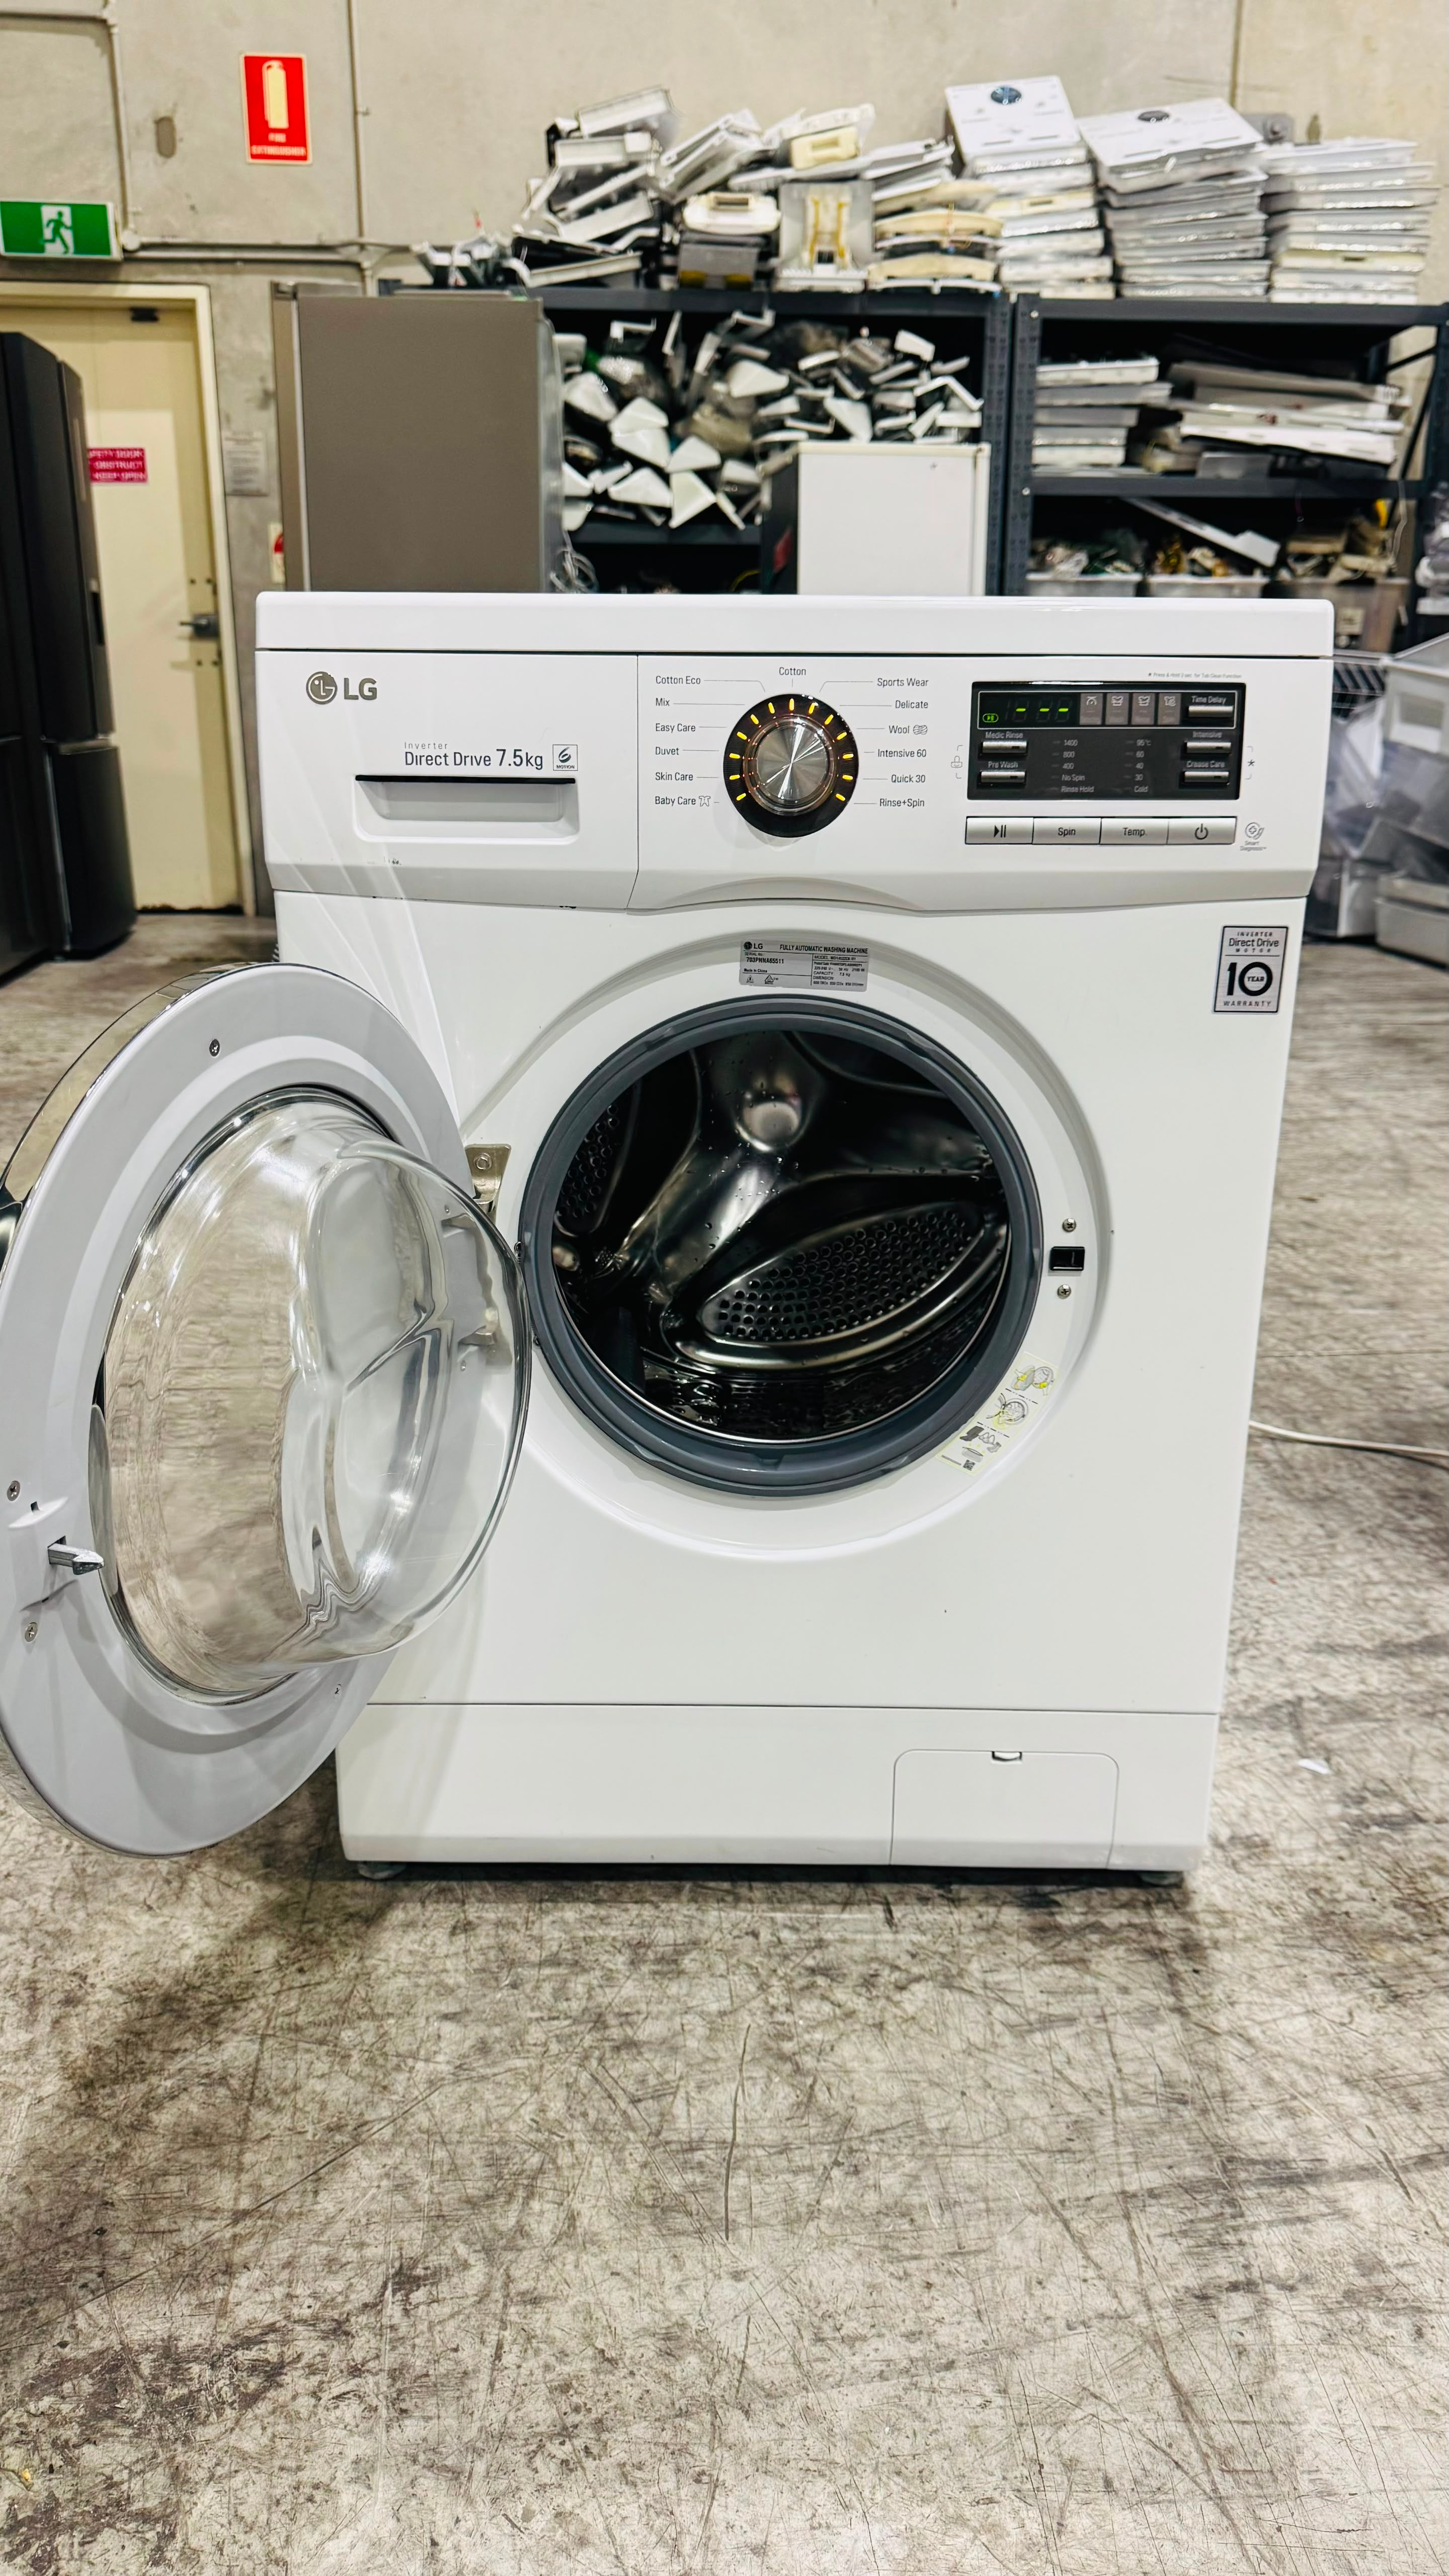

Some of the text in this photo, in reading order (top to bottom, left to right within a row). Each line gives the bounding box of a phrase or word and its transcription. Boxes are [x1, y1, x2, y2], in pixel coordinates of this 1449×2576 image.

[779, 667, 806, 676] Cotton
[656, 676, 701, 685] Cotton Eco
[877, 678, 928, 688] Sports Wear
[344, 678, 377, 700] LG
[656, 698, 670, 707] Mix
[895, 700, 928, 709] Delicate
[1208, 696, 1227, 704] Delay
[656, 723, 696, 734] Easy Care
[889, 725, 910, 734] Wool
[656, 747, 679, 755] Duvet
[878, 749, 927, 758] Intensive 60
[405, 752, 449, 766] Direct
[454, 752, 491, 766] Drive
[656, 772, 693, 781] Skin Care
[891, 775, 926, 783] Quick 30
[655, 796, 696, 807] Baby Care
[879, 798, 925, 808] Rinse+Spin
[1058, 828, 1076, 837] Spin
[1229, 938, 1279, 947] Direct Drive
[1227, 962, 1272, 996] 10
